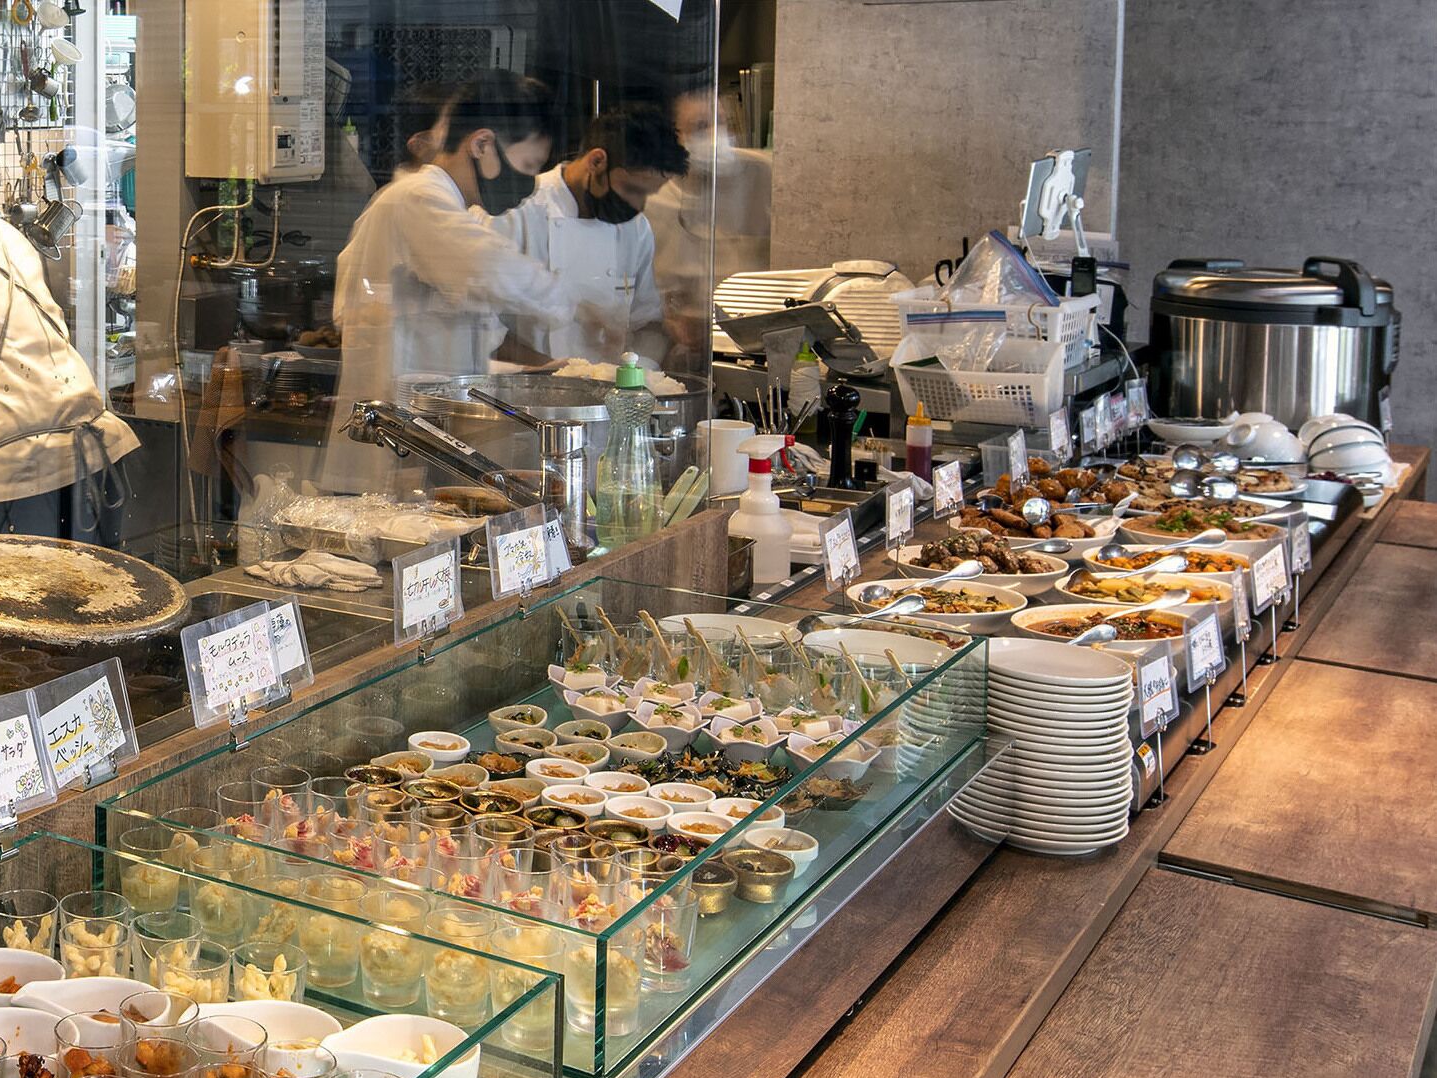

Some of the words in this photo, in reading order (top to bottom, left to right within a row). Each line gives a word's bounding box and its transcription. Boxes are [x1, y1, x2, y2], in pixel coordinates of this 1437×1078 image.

[228, 651, 252, 667] ムース
[48, 713, 82, 746] エスカ
